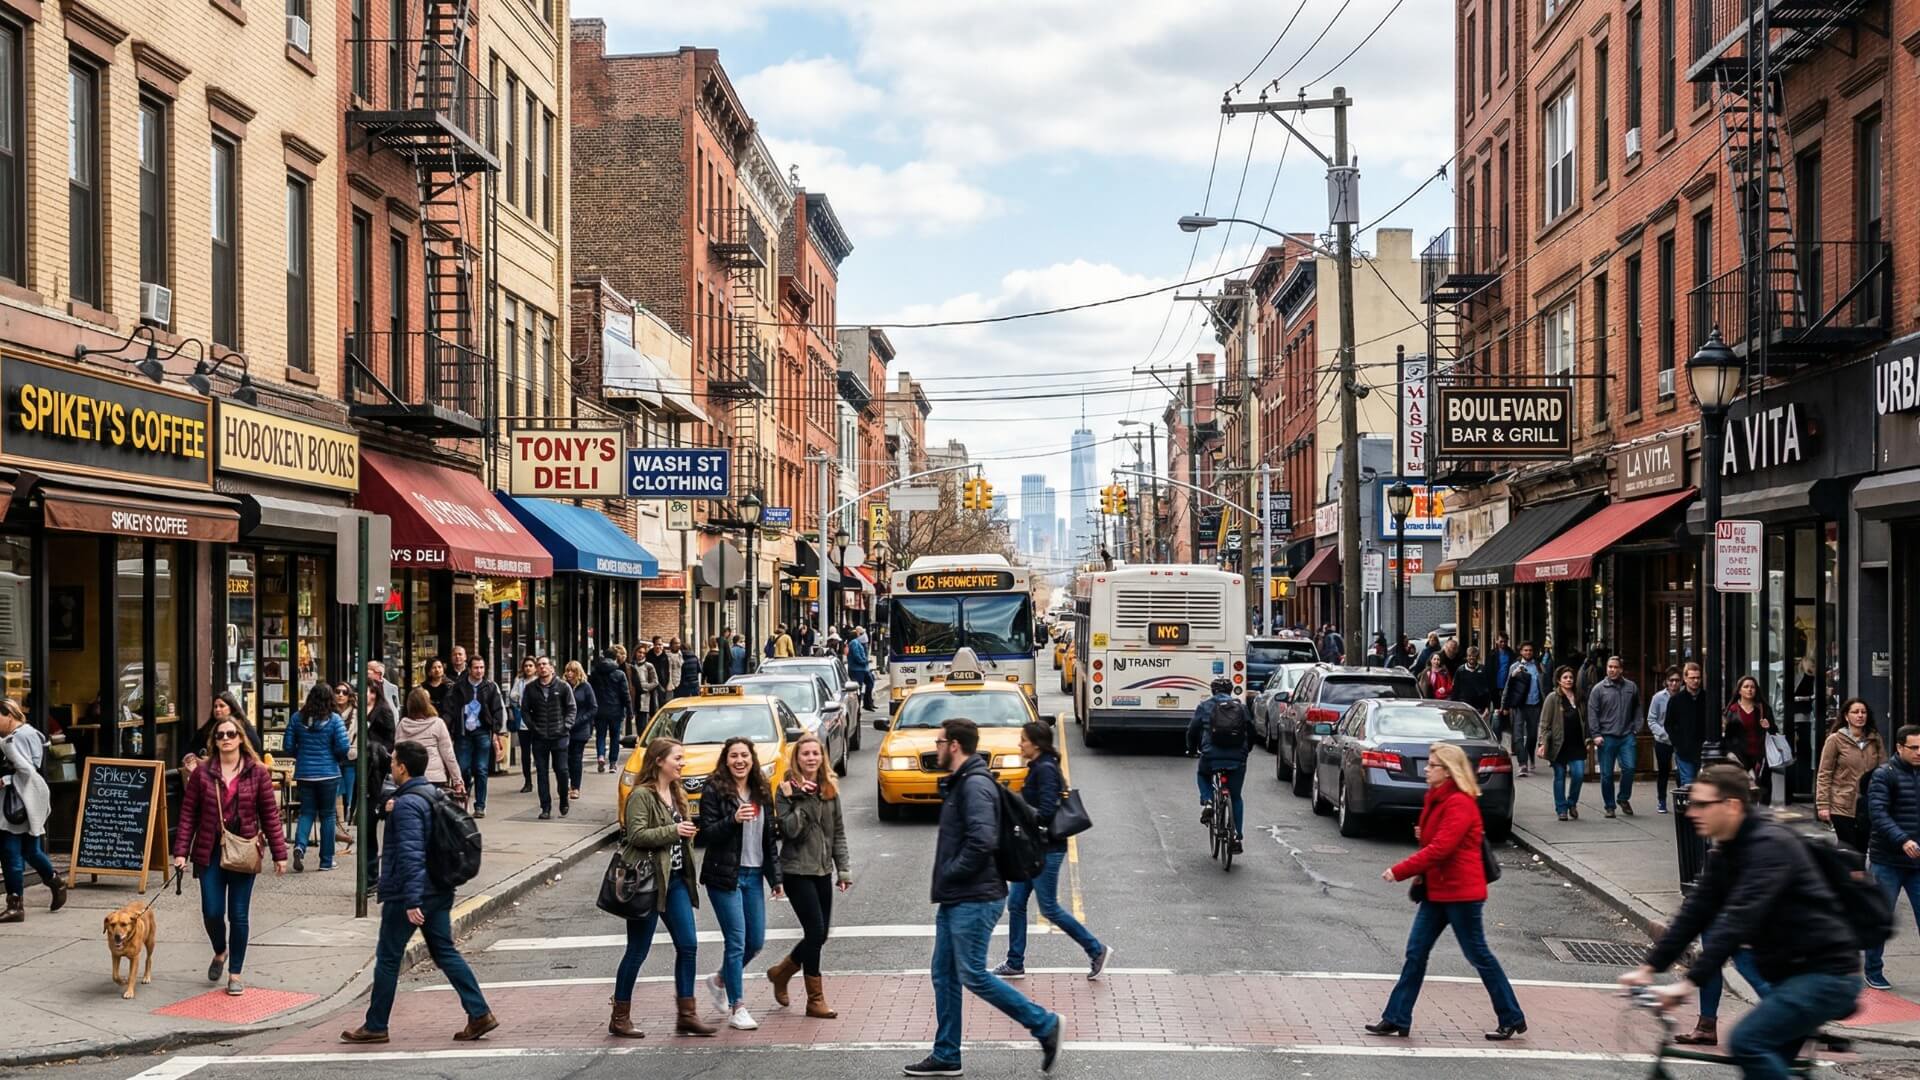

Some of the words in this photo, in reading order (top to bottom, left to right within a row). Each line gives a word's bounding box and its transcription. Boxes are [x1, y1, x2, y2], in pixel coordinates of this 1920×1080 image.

[1448, 398, 1562, 422] BOULEVARD
[20, 383, 126, 446] SPIKEY'S
[131, 408, 205, 458] COFFEE
[1451, 428, 1487, 442] BAR
[1492, 428, 1505, 442] &
[1509, 428, 1559, 442] GRILL
[1720, 419, 1738, 476] A
[1744, 403, 1801, 470] VITA
[225, 417, 304, 469] HOBOKEN
[308, 435, 355, 479] BOOKS
[516, 437, 616, 461] TONY'S
[633, 456, 691, 472] WASH
[697, 456, 723, 472] ST
[1627, 452, 1641, 477] LA
[1643, 444, 1671, 473] VITA
[534, 467, 598, 489] DELI
[632, 475, 723, 491] CLOTHING
[111, 511, 153, 533] SPIKEY'S
[154, 515, 188, 535] COFFEE
[416, 549, 445, 562] DELI
[916, 575, 936, 590] 126
[1158, 625, 1180, 639] NYC
[1128, 658, 1172, 668] TRANSIT
[98, 788, 129, 799] COFFEE
